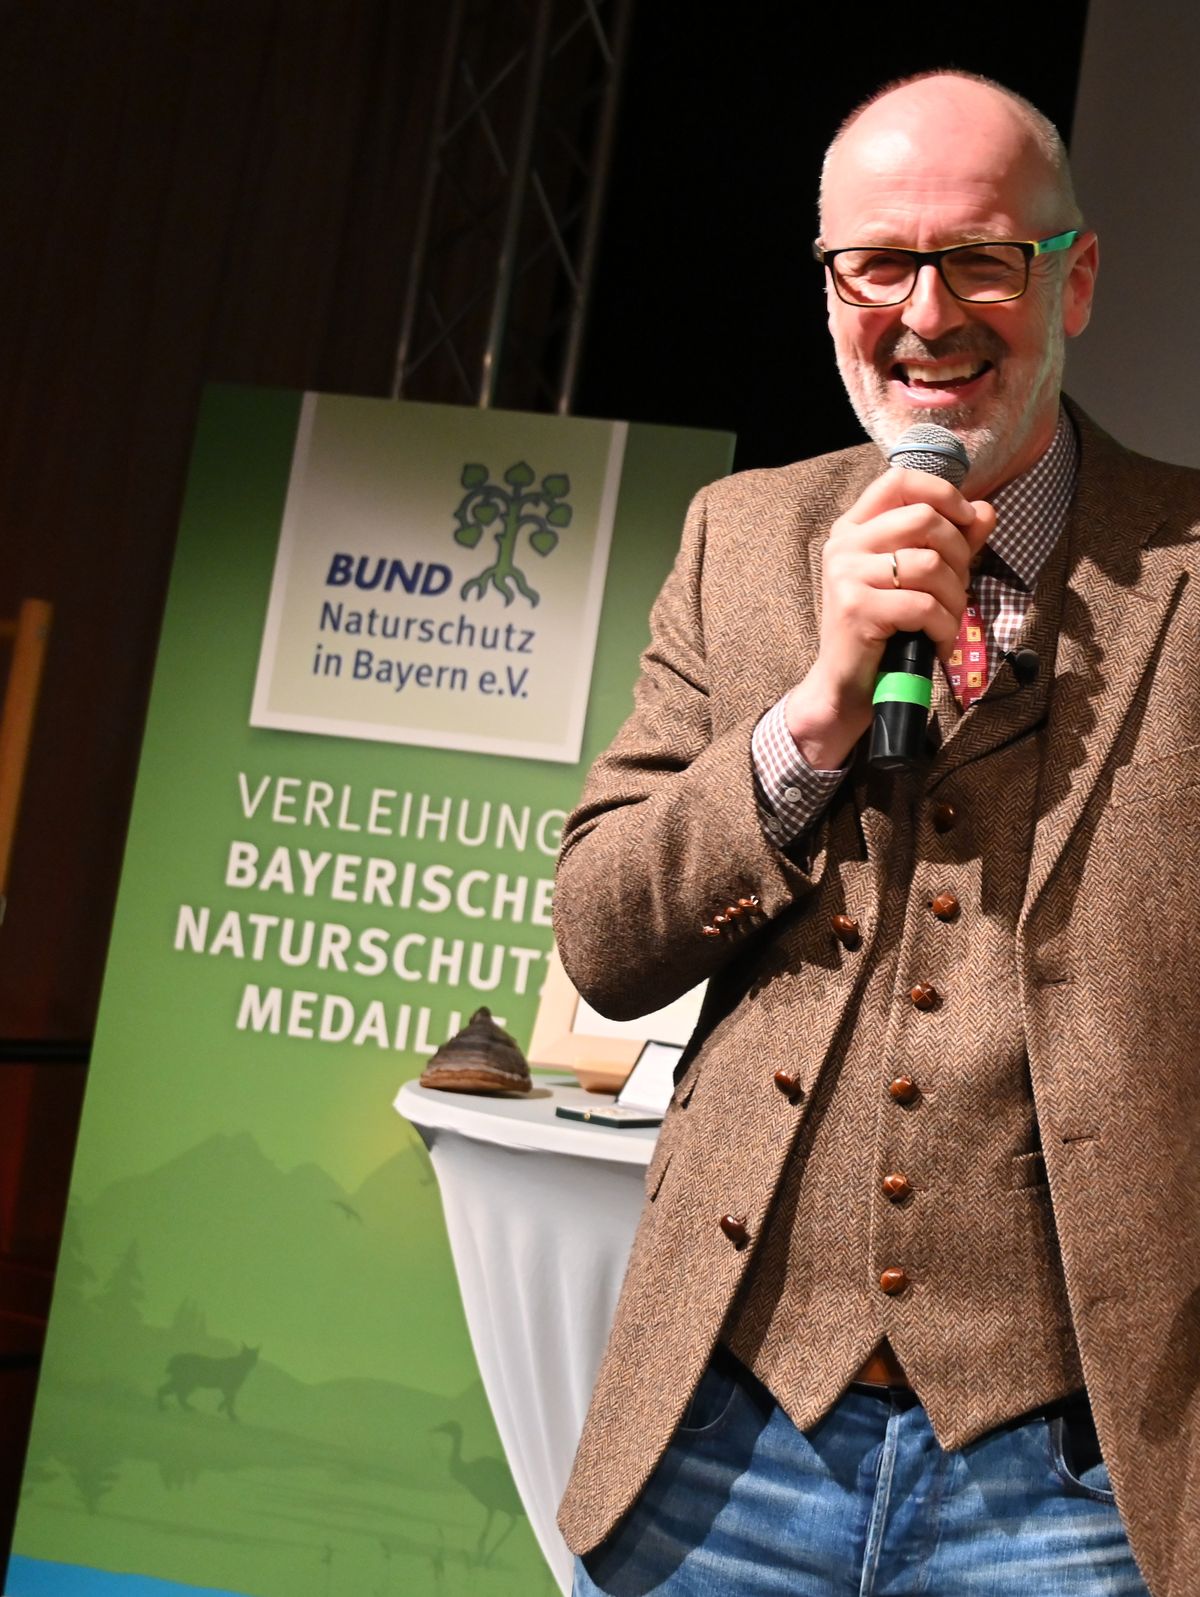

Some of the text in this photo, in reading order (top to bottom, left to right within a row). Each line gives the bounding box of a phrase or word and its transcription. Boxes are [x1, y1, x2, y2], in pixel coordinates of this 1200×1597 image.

[325, 552, 453, 597] BUND
[319, 601, 536, 654] Naturschutz
[312, 644, 529, 698] in Bayern e.V.
[238, 772, 569, 856] VERLEIHUNG
[225, 840, 555, 927] BAYERISCHE
[174, 904, 554, 996] NATURSCHUT
